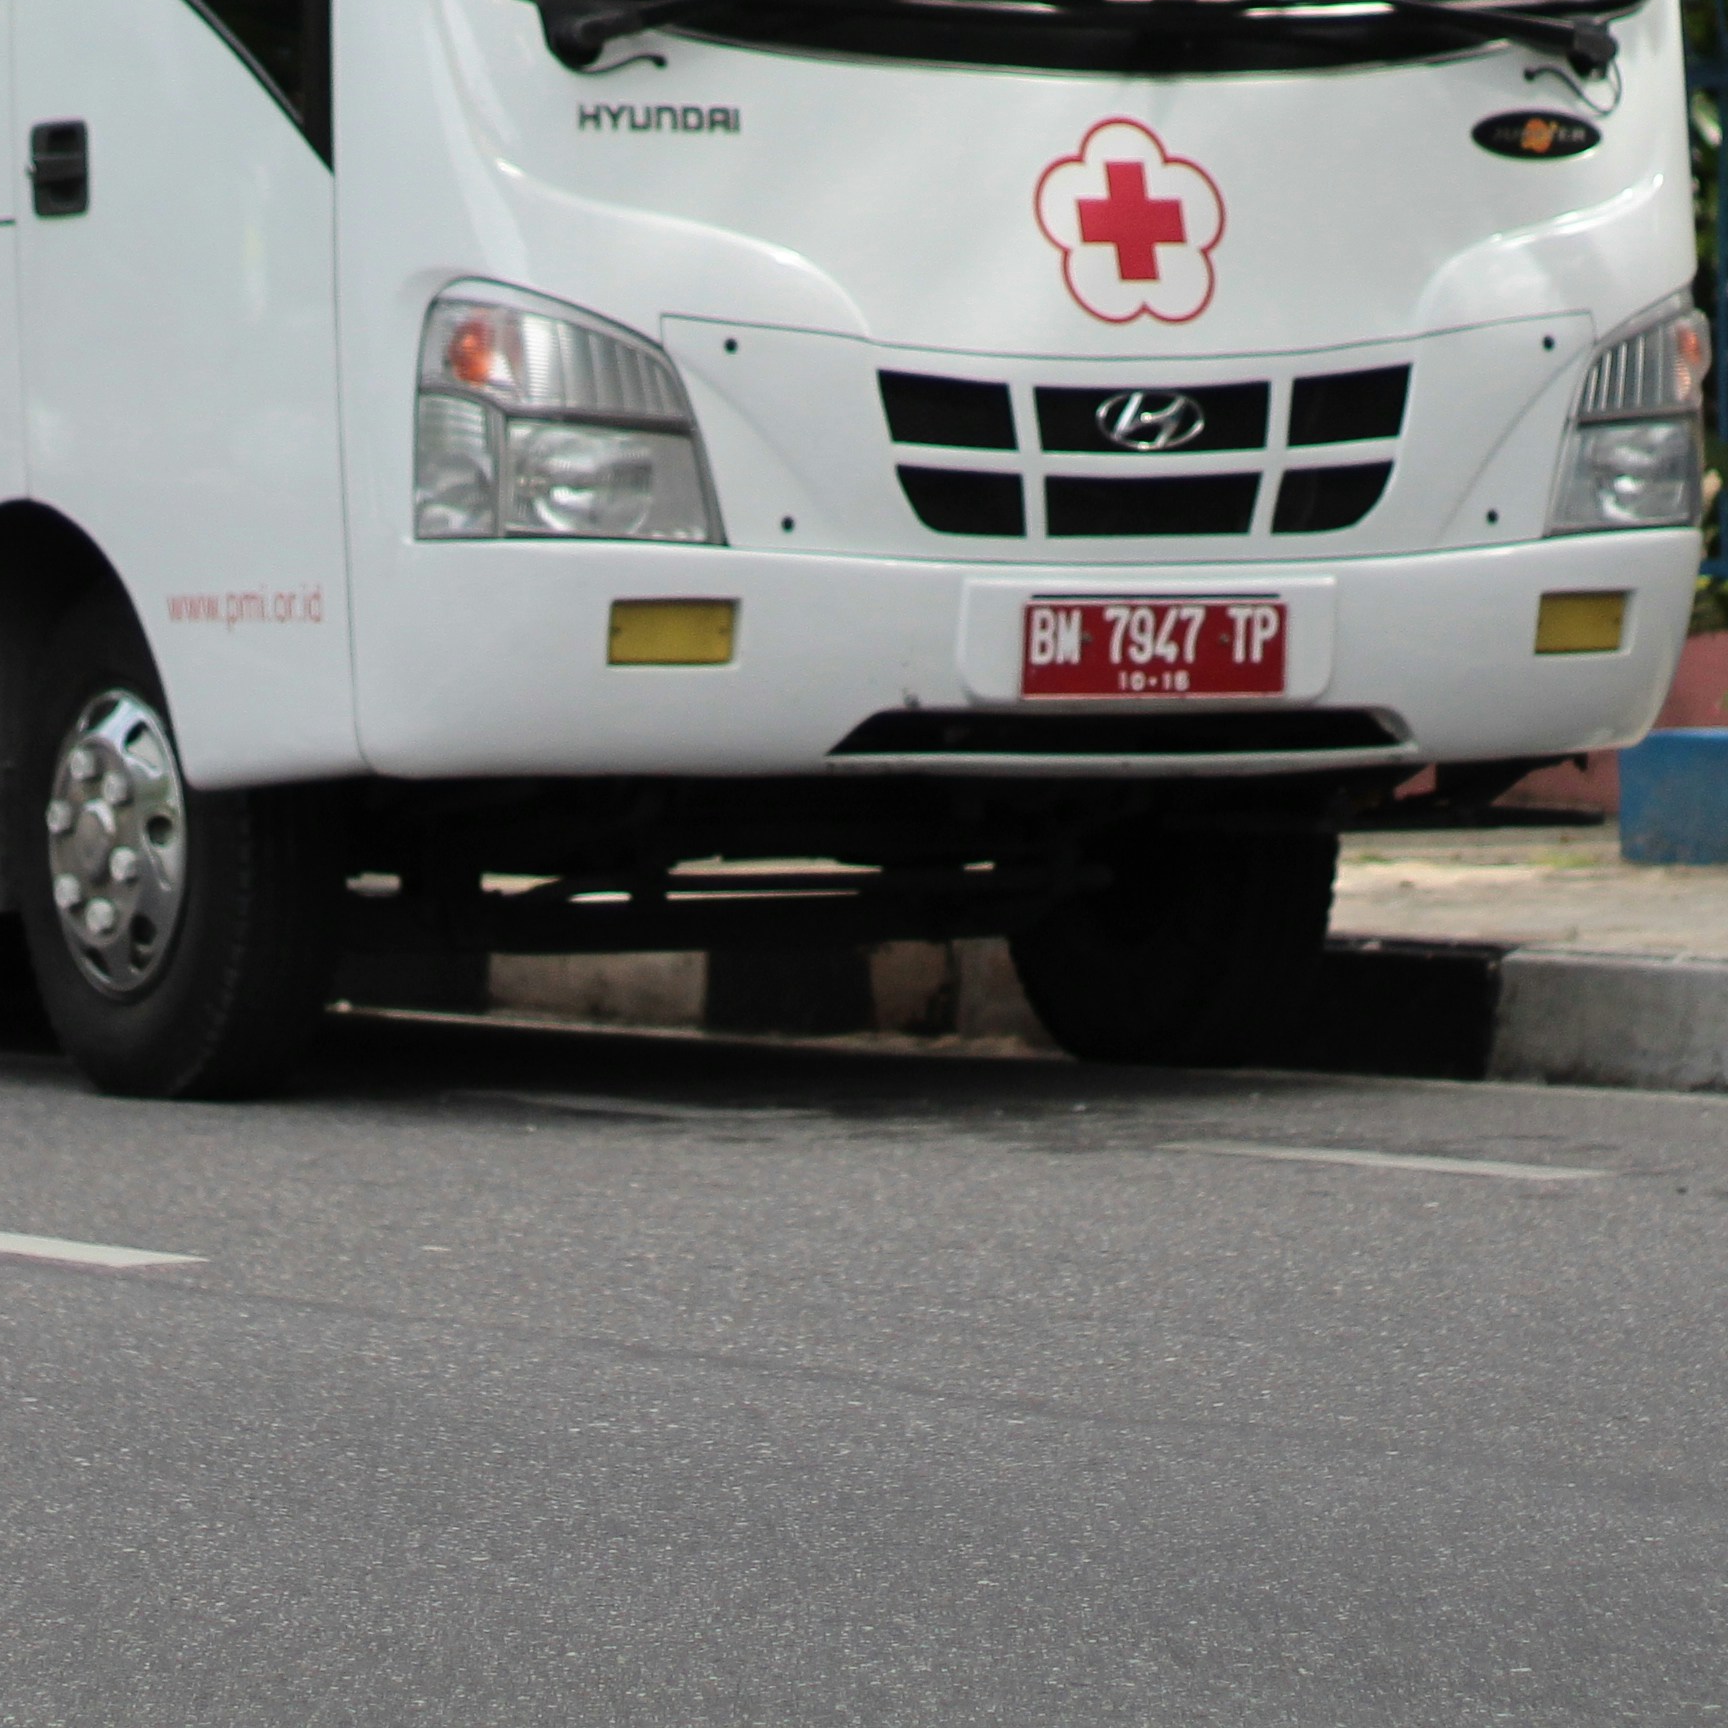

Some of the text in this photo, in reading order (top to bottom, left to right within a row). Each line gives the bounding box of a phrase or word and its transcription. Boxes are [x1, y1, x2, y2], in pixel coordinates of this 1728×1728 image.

[578, 103, 741, 133] HYUNDAI
[167, 582, 322, 633] www.pmi.or.id
[1030, 605, 1279, 665] BM 7947 TP
